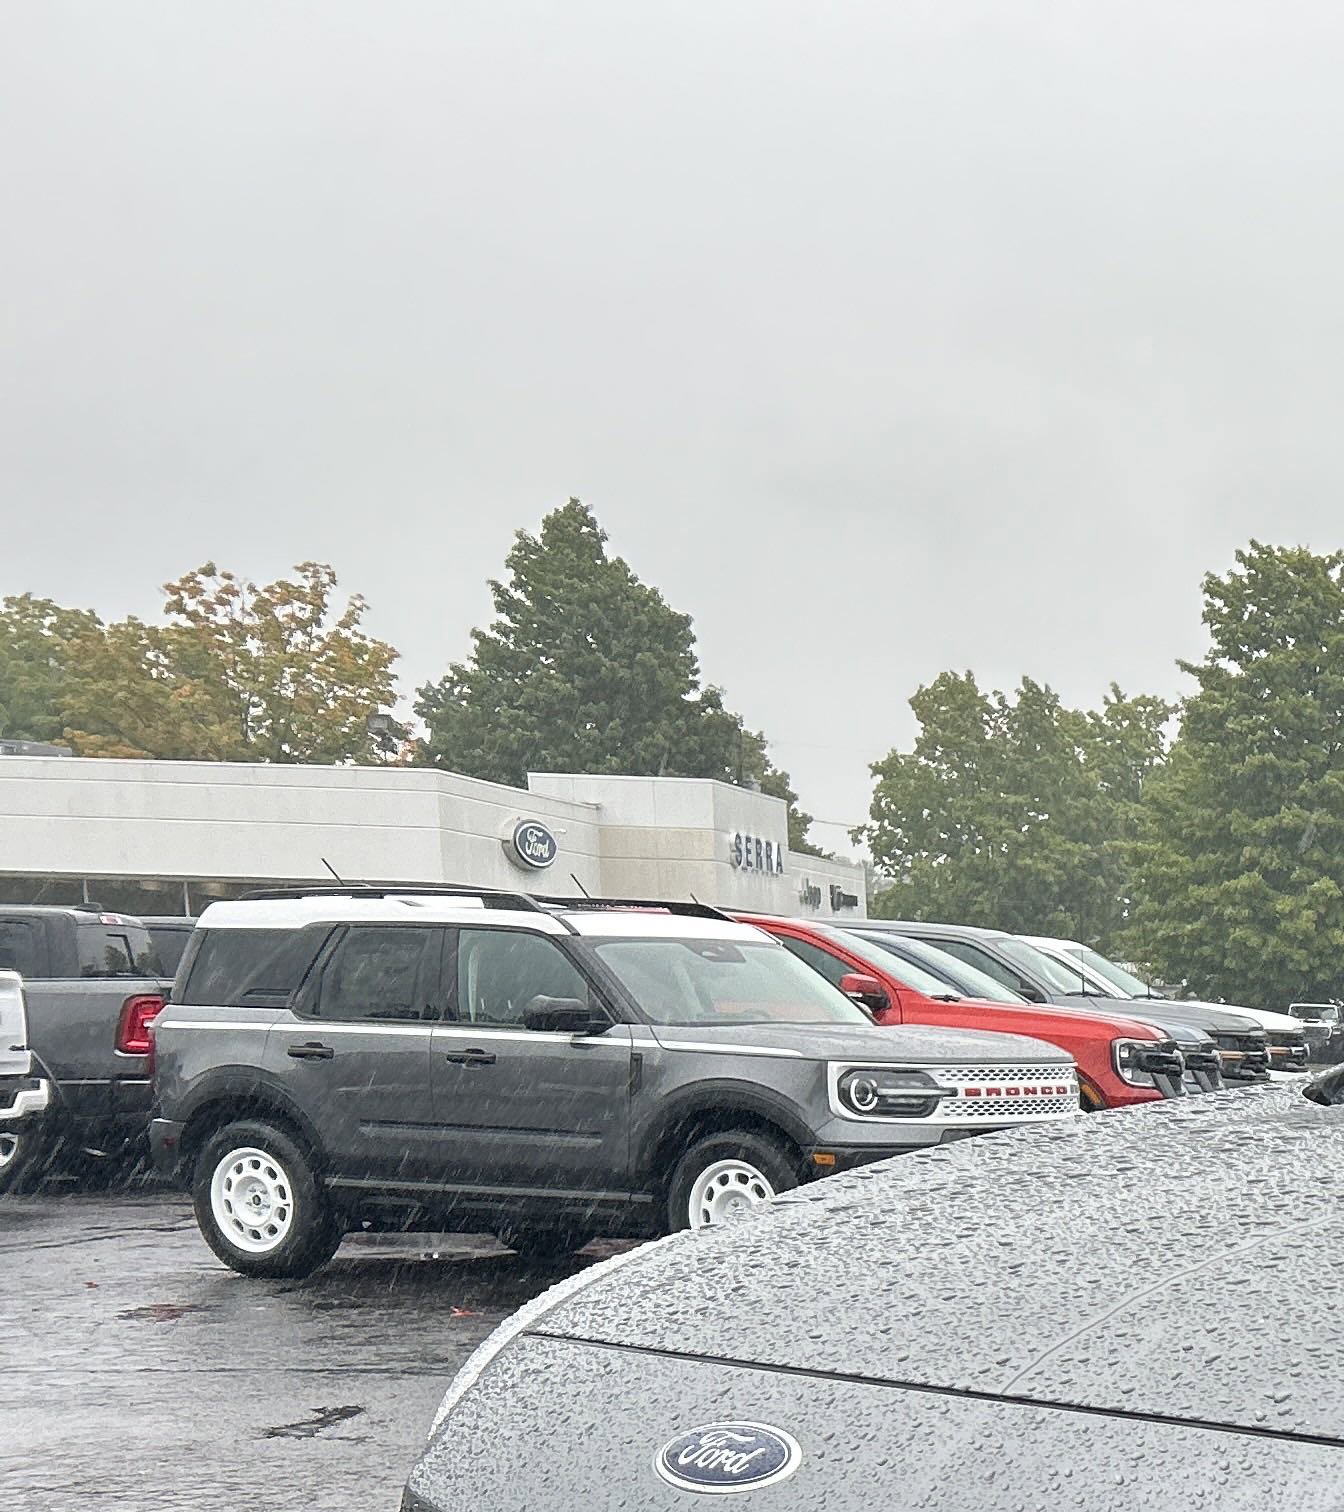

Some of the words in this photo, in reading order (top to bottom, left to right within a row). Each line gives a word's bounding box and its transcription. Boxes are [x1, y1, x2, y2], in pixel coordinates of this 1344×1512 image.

[526, 828, 549, 858] Ford
[735, 832, 783, 874] SERRA
[964, 1086, 1068, 1097] BRONCO
[677, 1431, 766, 1474] Ford
